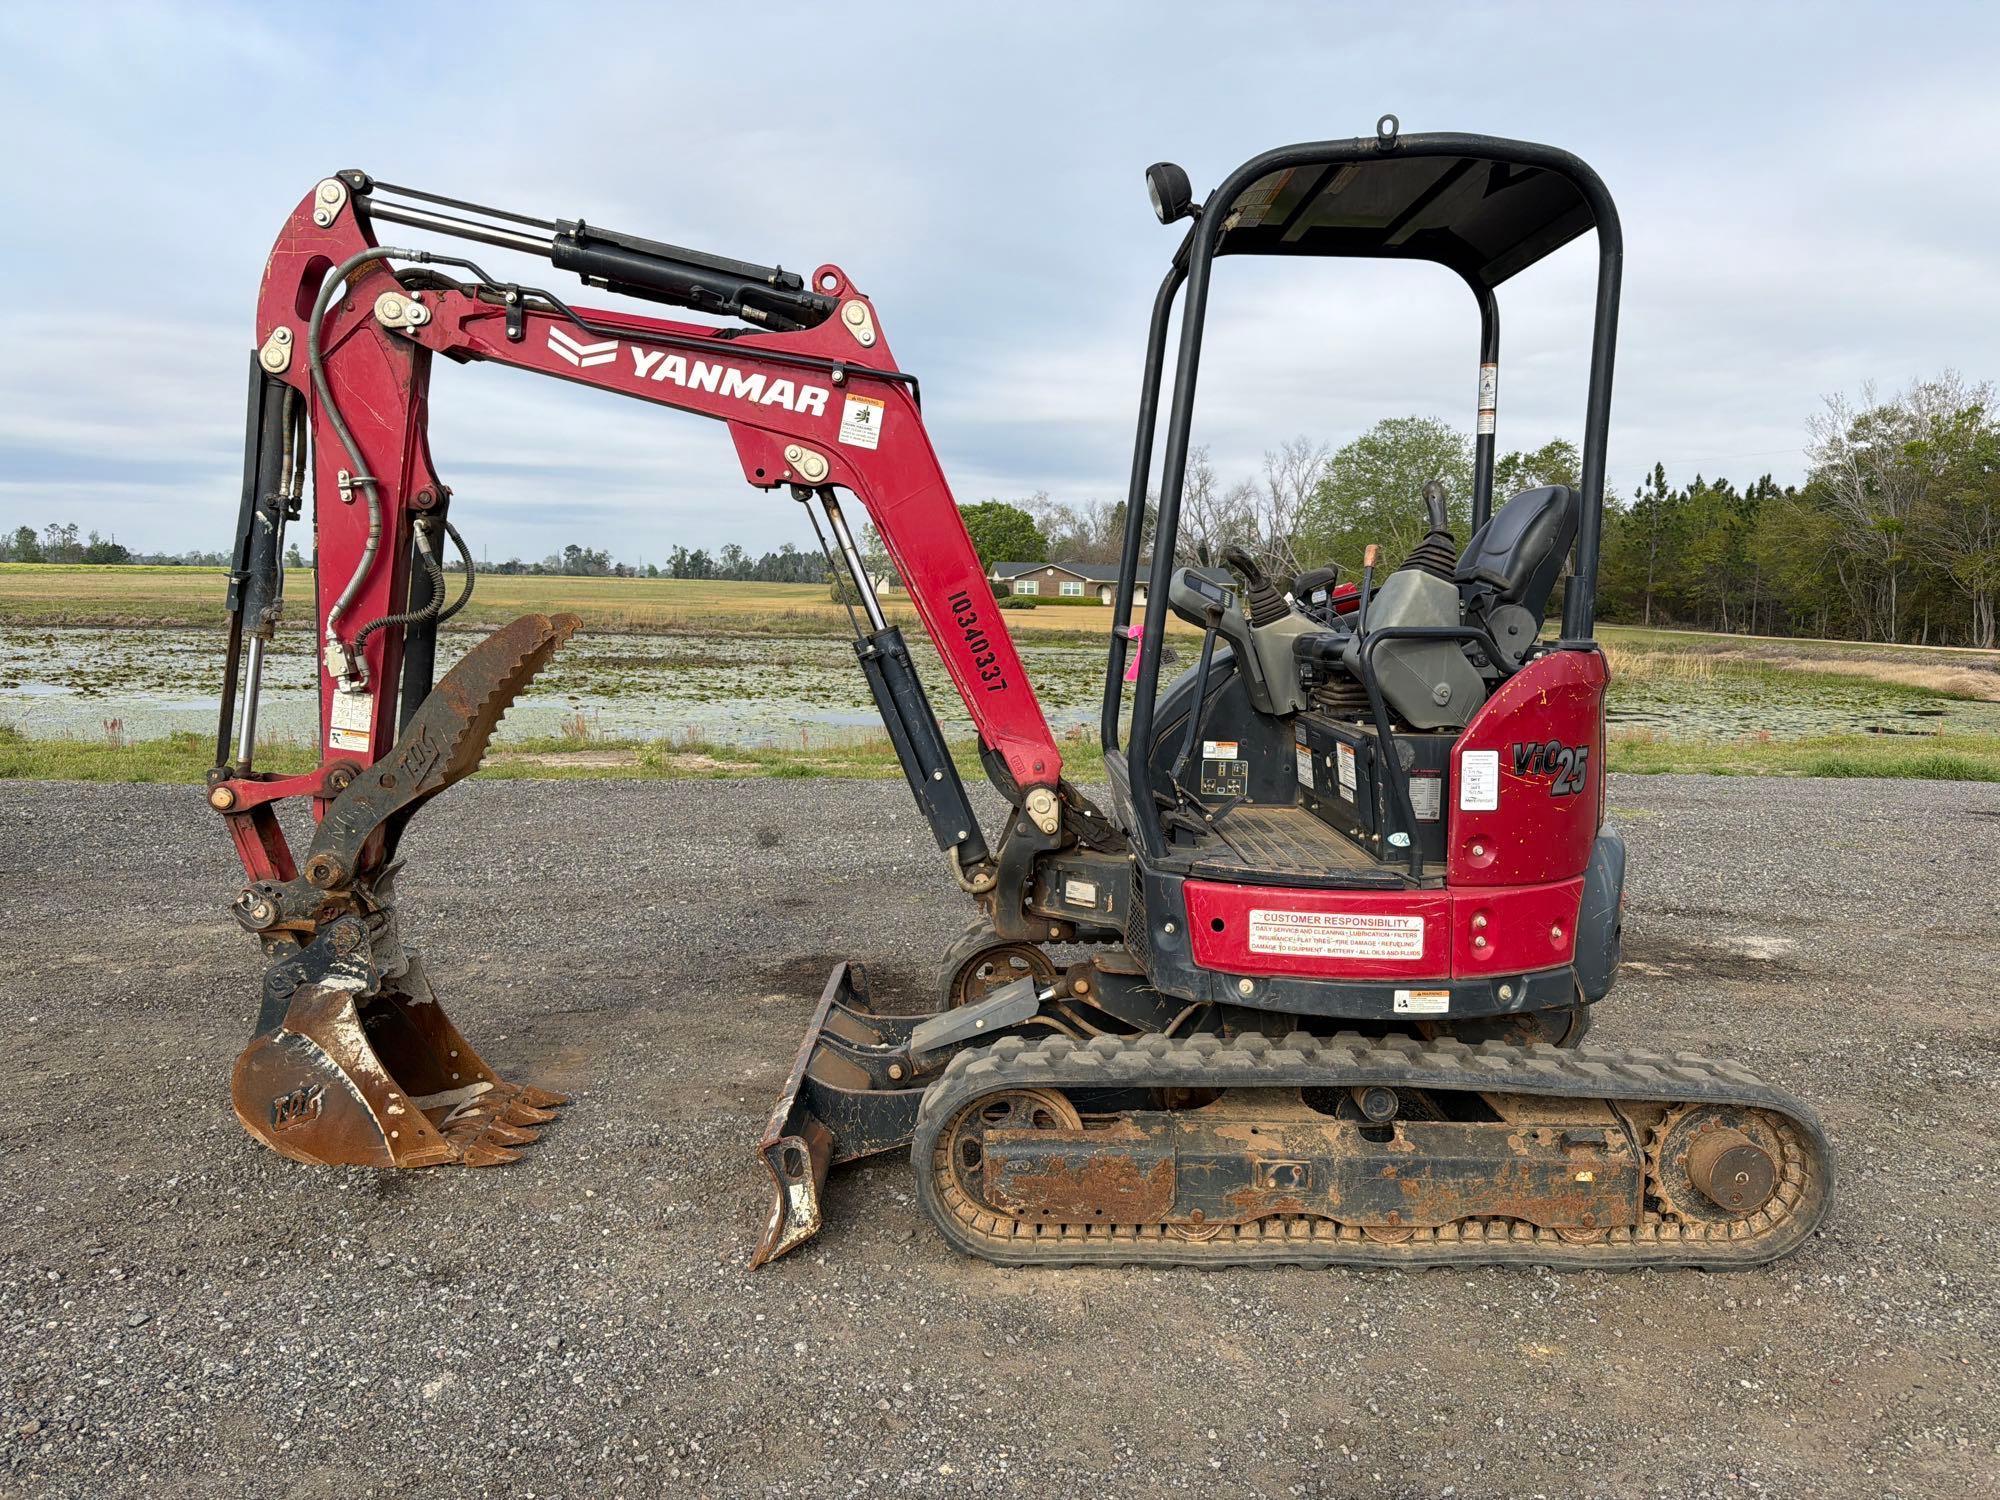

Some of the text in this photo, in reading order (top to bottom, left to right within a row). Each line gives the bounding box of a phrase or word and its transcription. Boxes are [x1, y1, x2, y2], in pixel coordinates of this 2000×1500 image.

[630, 346, 830, 417] YANMAR
[947, 590, 1008, 692] 10340337
[1263, 913, 1409, 927] CUSTOMER RESPONSIBILITY
[1287, 945, 1323, 953] EQUIPMENT
